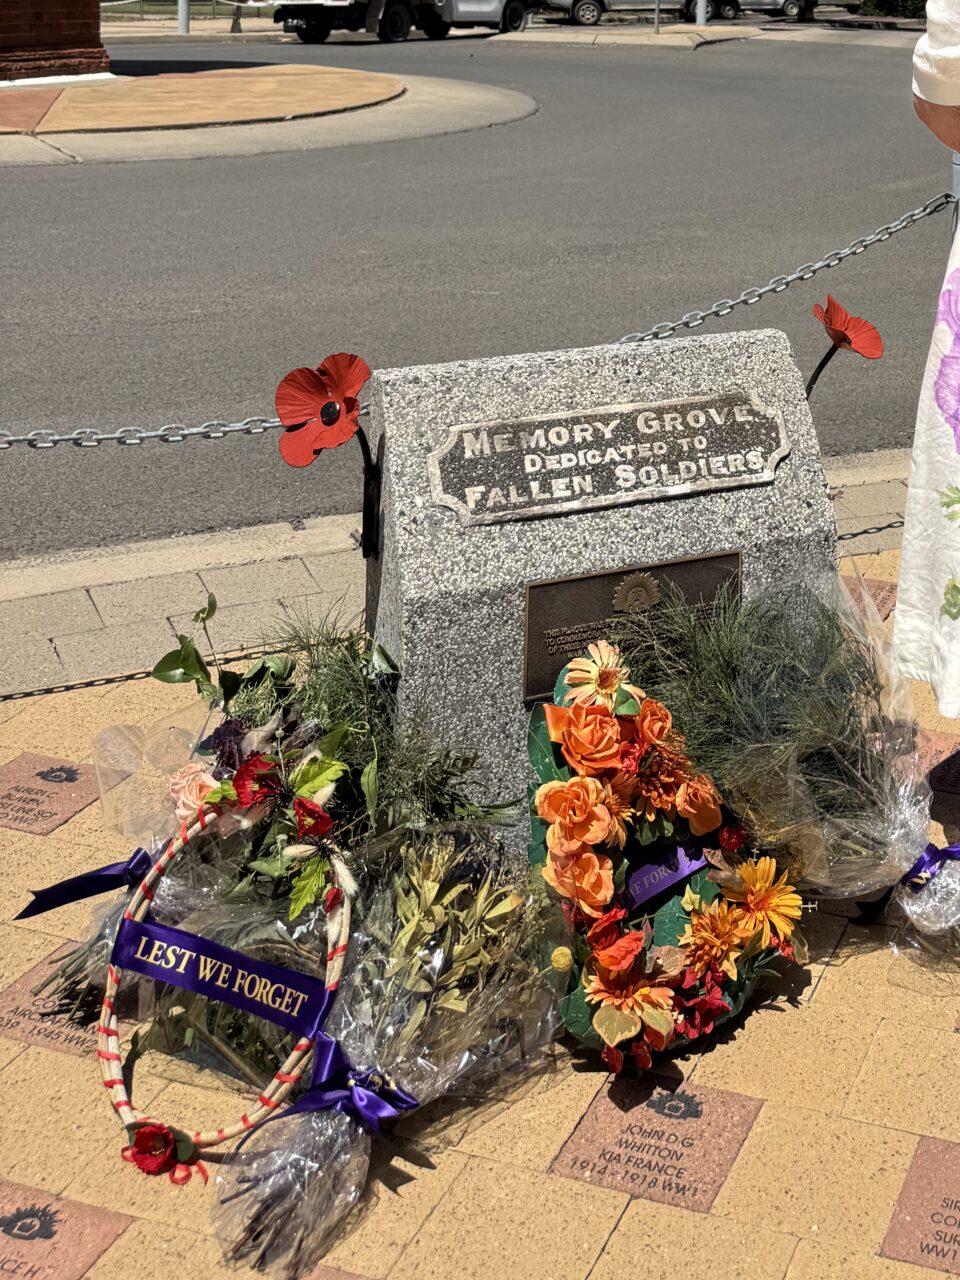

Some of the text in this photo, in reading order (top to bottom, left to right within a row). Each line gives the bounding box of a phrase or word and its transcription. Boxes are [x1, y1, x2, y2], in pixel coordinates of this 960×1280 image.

[463, 405, 753, 459] MEMORY GROVE
[524, 436, 708, 473] DEDICATED TO
[464, 451, 766, 510] FALLEN SOLDIERS
[544, 629, 560, 638] THIS
[545, 638, 555, 646] TO
[134, 935, 309, 1017] LEST WE FORGET
[29, 1026, 62, 1040] 1945
[64, 1033, 98, 1049] WW2
[621, 1123, 694, 1147] JOHN D G
[618, 1137, 683, 1162] WHITTON
[599, 1149, 687, 1179] KIA FRANCE
[570, 1157, 698, 1197] 1914 1918 WW1
[920, 1241, 958, 1261] WW1
[24, 1264, 41, 1278] H
